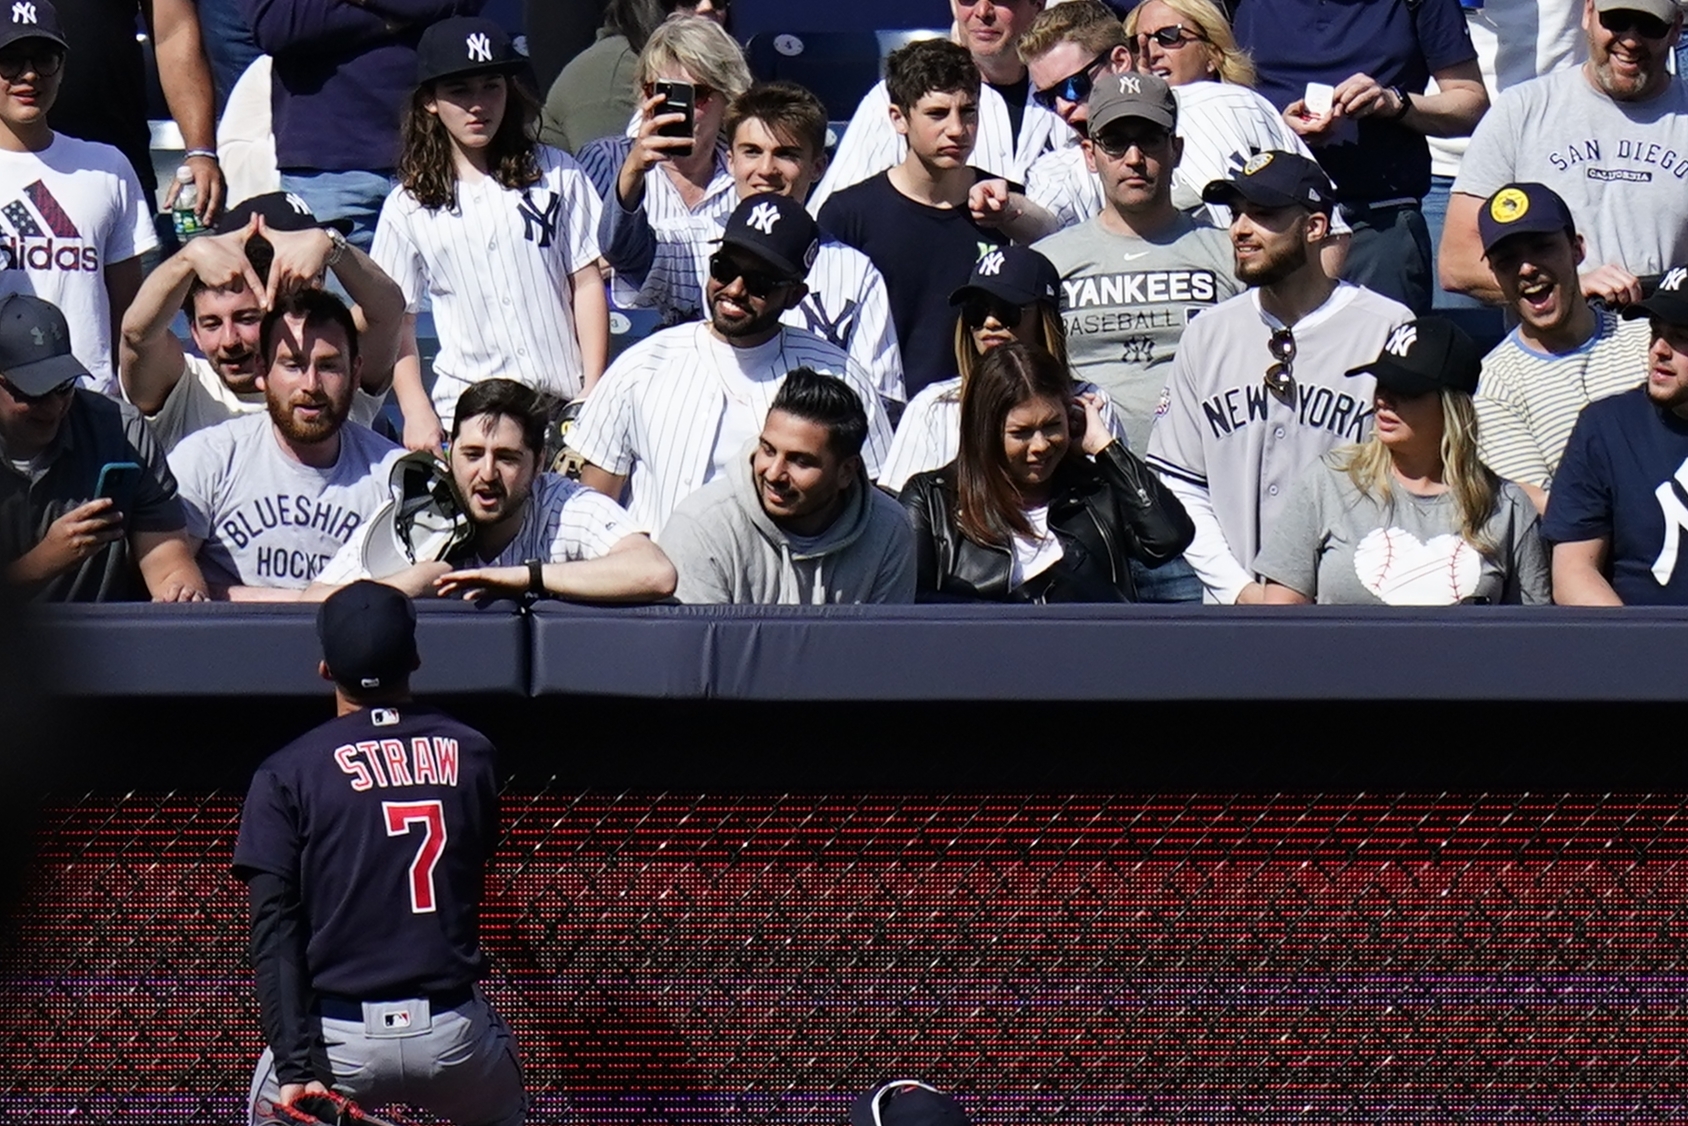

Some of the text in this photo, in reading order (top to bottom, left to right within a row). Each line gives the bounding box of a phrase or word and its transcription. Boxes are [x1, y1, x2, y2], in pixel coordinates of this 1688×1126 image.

[1549, 139, 1602, 171] SAN
[1062, 272, 1215, 308] YANKEES
[1062, 308, 1180, 337] BASEBALL
[1201, 383, 1270, 440] NEW
[1297, 383, 1374, 444] YORK
[223, 494, 362, 549] BLUESHIR
[257, 546, 331, 580] HOCKE
[334, 736, 459, 792] STRAW
[381, 800, 448, 914] 7
